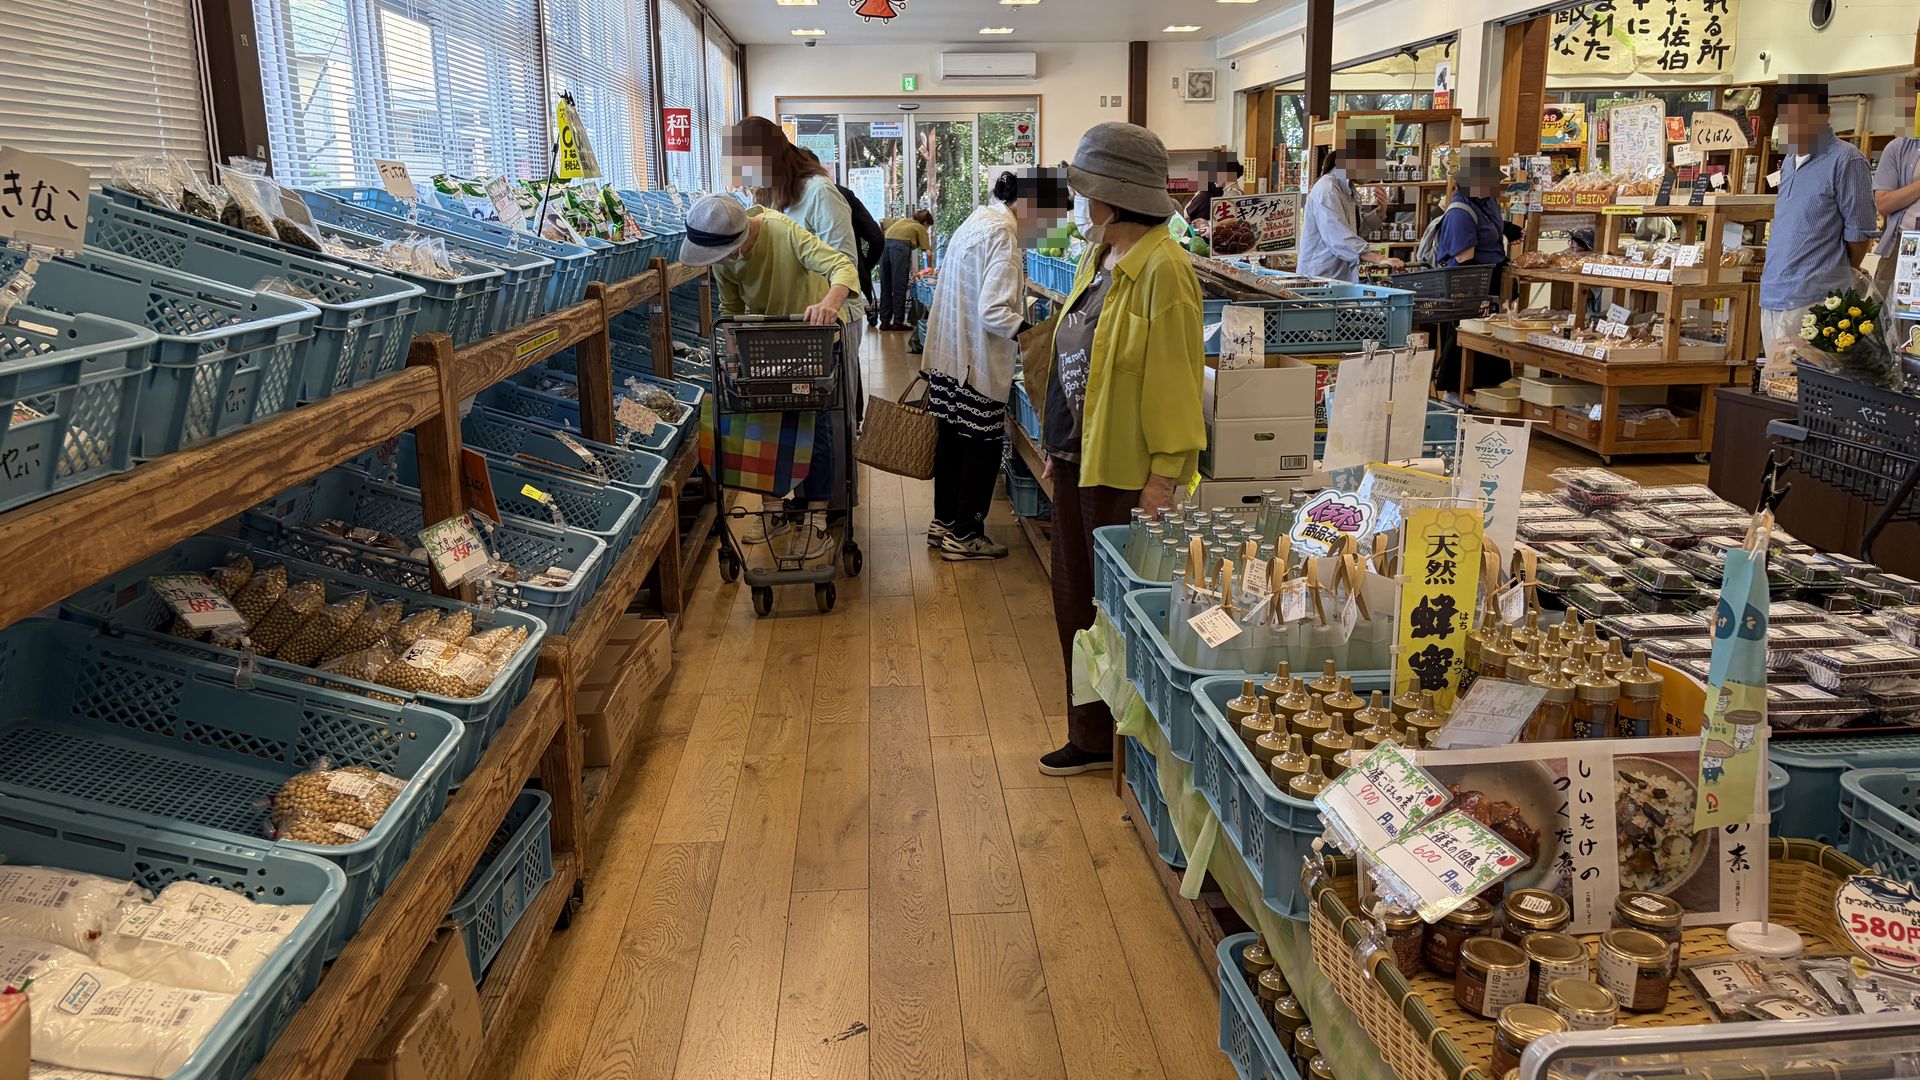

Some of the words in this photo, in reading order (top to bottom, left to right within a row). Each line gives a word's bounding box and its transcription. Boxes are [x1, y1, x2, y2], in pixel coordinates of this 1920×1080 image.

[1657, 0, 1690, 70] た佐伯
[667, 114, 690, 137] 秤
[667, 137, 690, 146] はかり
[2, 169, 80, 230] きなこ
[1236, 199, 1281, 220] キクラゲ
[1215, 201, 1235, 222] 生
[1475, 446, 1514, 455] マリンレモン
[1307, 498, 1363, 531] イチオシ
[1425, 533, 1459, 585] 天然
[1459, 612, 1469, 630] はち
[1408, 593, 1459, 691] 蜂蜜
[405, 648, 425, 661] 大豆
[1454, 657, 1463, 675] みつ
[1356, 784, 1380, 806] 900
[1553, 776, 1577, 875] つくだ煮
[1578, 759, 1600, 881] しいたけの
[1412, 844, 1442, 863] 600
[1713, 969, 1739, 991] かつお
